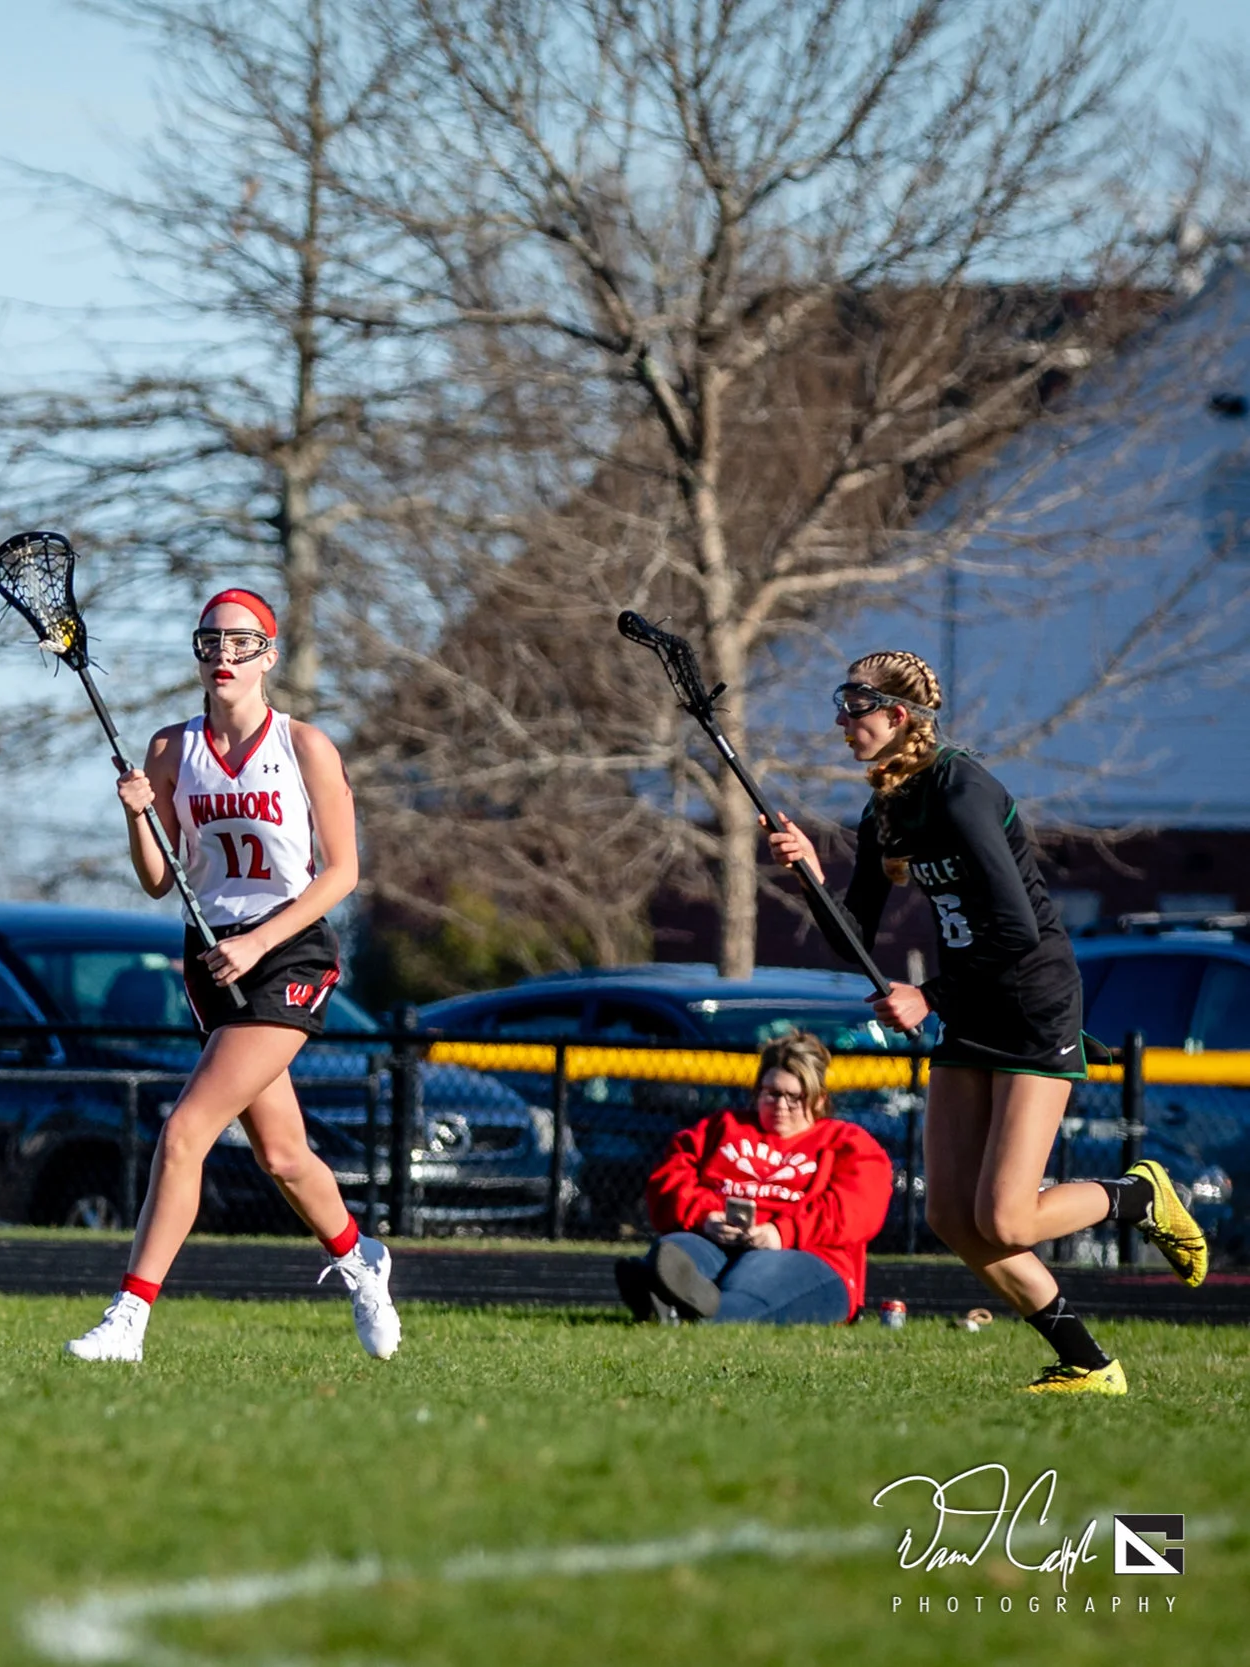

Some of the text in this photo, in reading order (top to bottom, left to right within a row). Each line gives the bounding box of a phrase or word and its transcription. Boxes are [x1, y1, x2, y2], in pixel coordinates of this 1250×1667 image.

[189, 790, 283, 829] WARRIORS
[213, 832, 271, 880] 12
[931, 893, 974, 948] 6
[286, 982, 314, 1007] W
